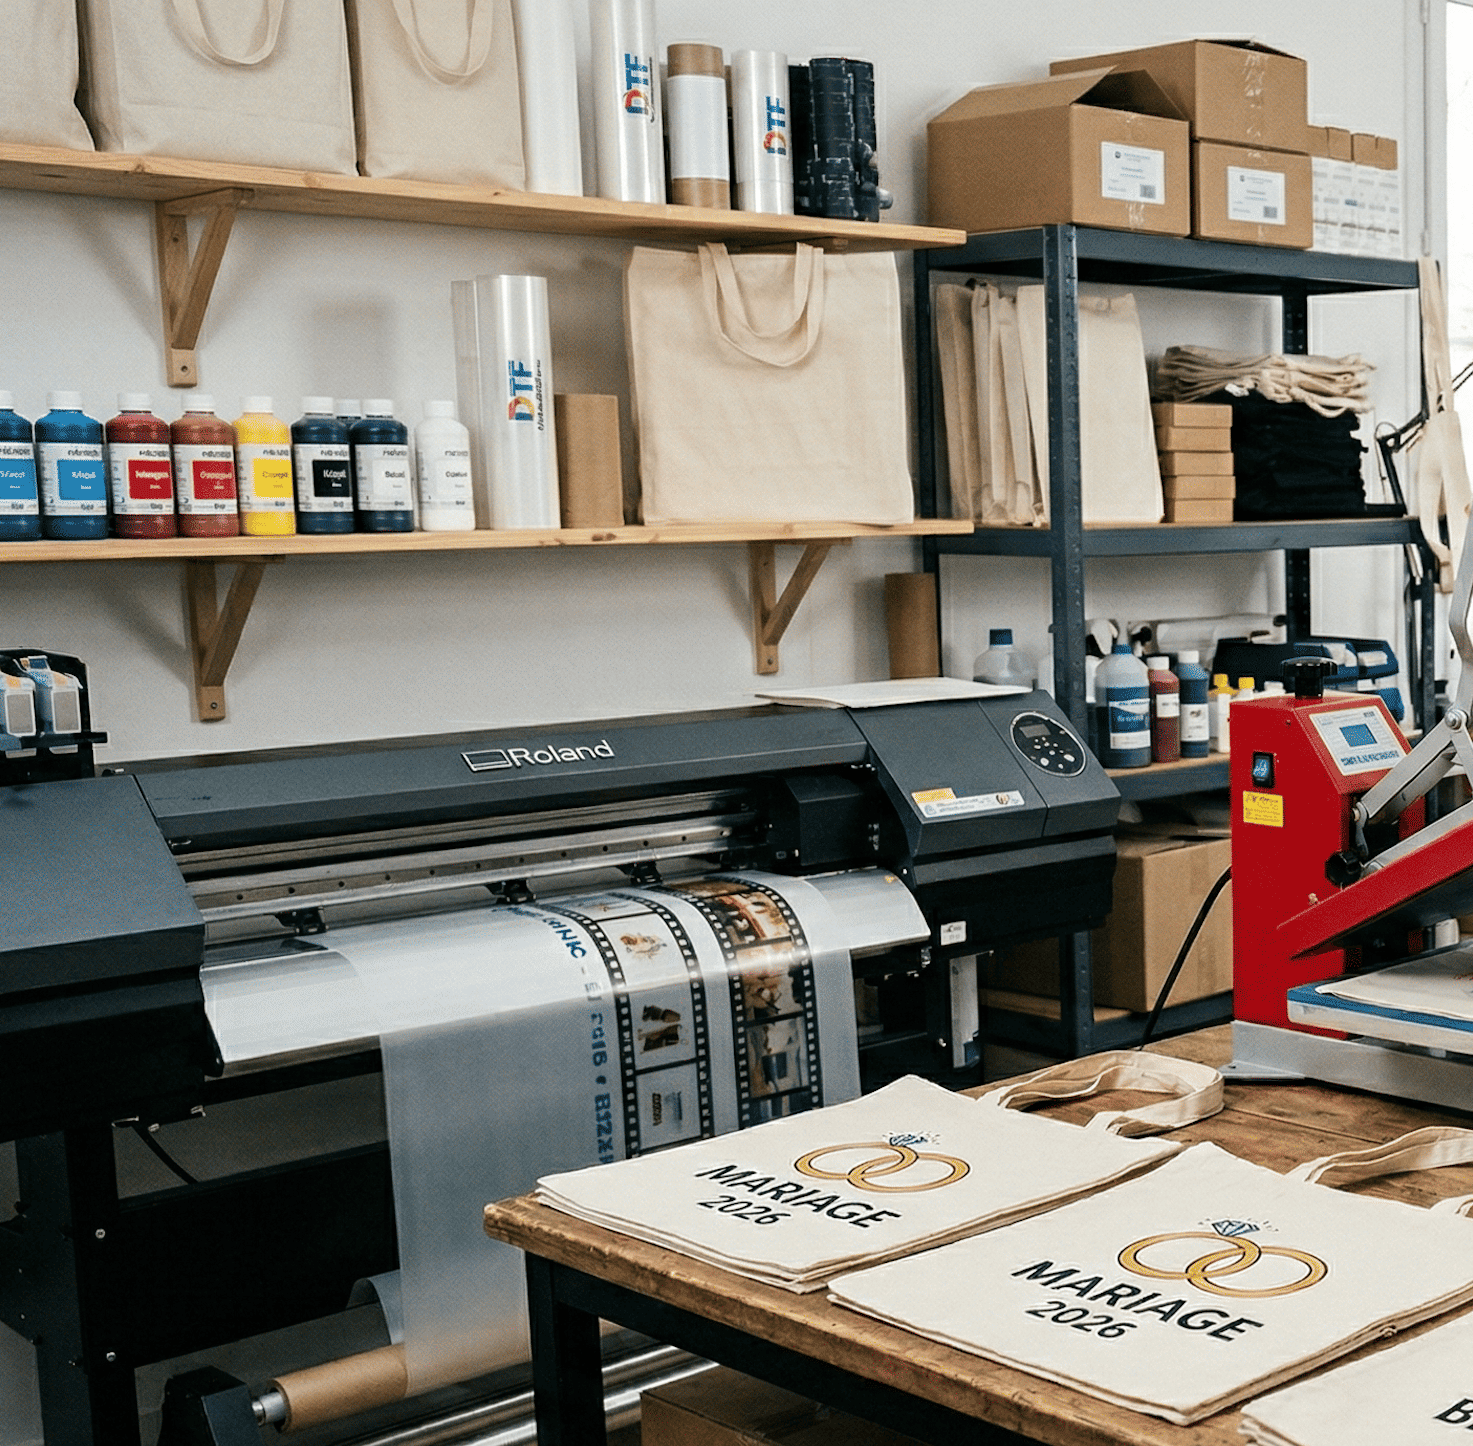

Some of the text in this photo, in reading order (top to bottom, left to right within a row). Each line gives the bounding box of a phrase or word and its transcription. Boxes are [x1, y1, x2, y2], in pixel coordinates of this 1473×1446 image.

[763, 96, 787, 156] DTF
[508, 360, 534, 421] DTF
[507, 739, 615, 768] Roland
[695, 1165, 902, 1228] MARIAGE
[697, 1195, 791, 1225] 2026
[1011, 1260, 1264, 1342] MARIAGE
[1025, 1301, 1138, 1338] 2026
